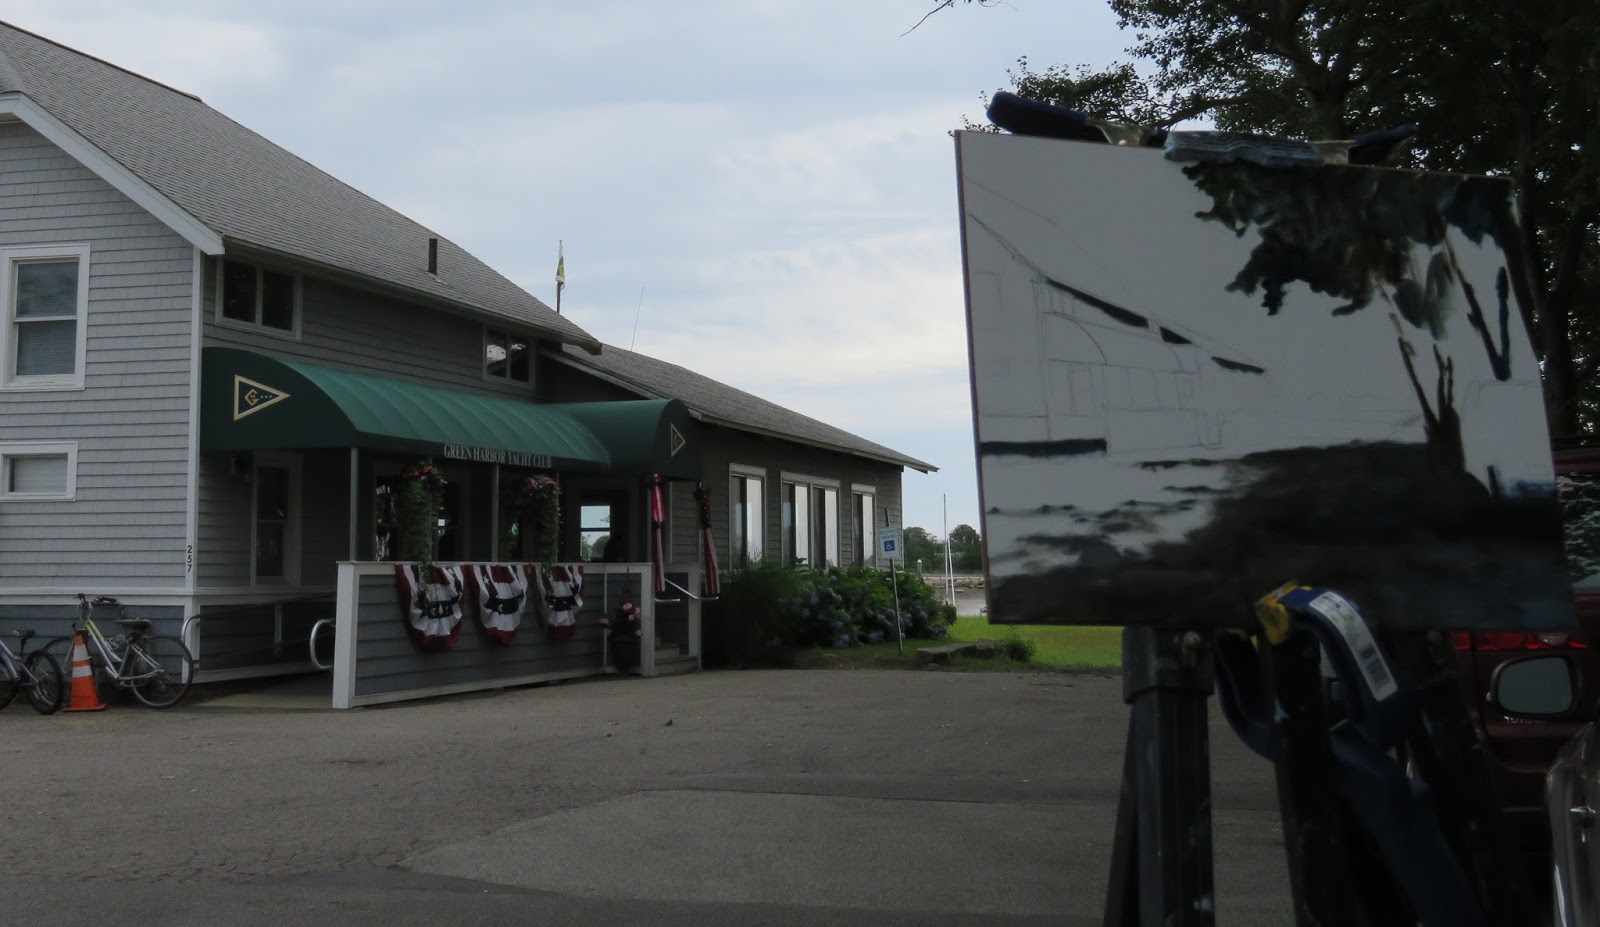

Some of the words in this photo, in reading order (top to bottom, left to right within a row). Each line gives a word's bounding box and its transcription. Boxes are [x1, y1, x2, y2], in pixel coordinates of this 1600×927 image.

[444, 443, 472, 459] GREEN
[473, 447, 506, 464] HARBOR
[508, 451, 531, 467] YACHT
[533, 454, 552, 469] CLUB
